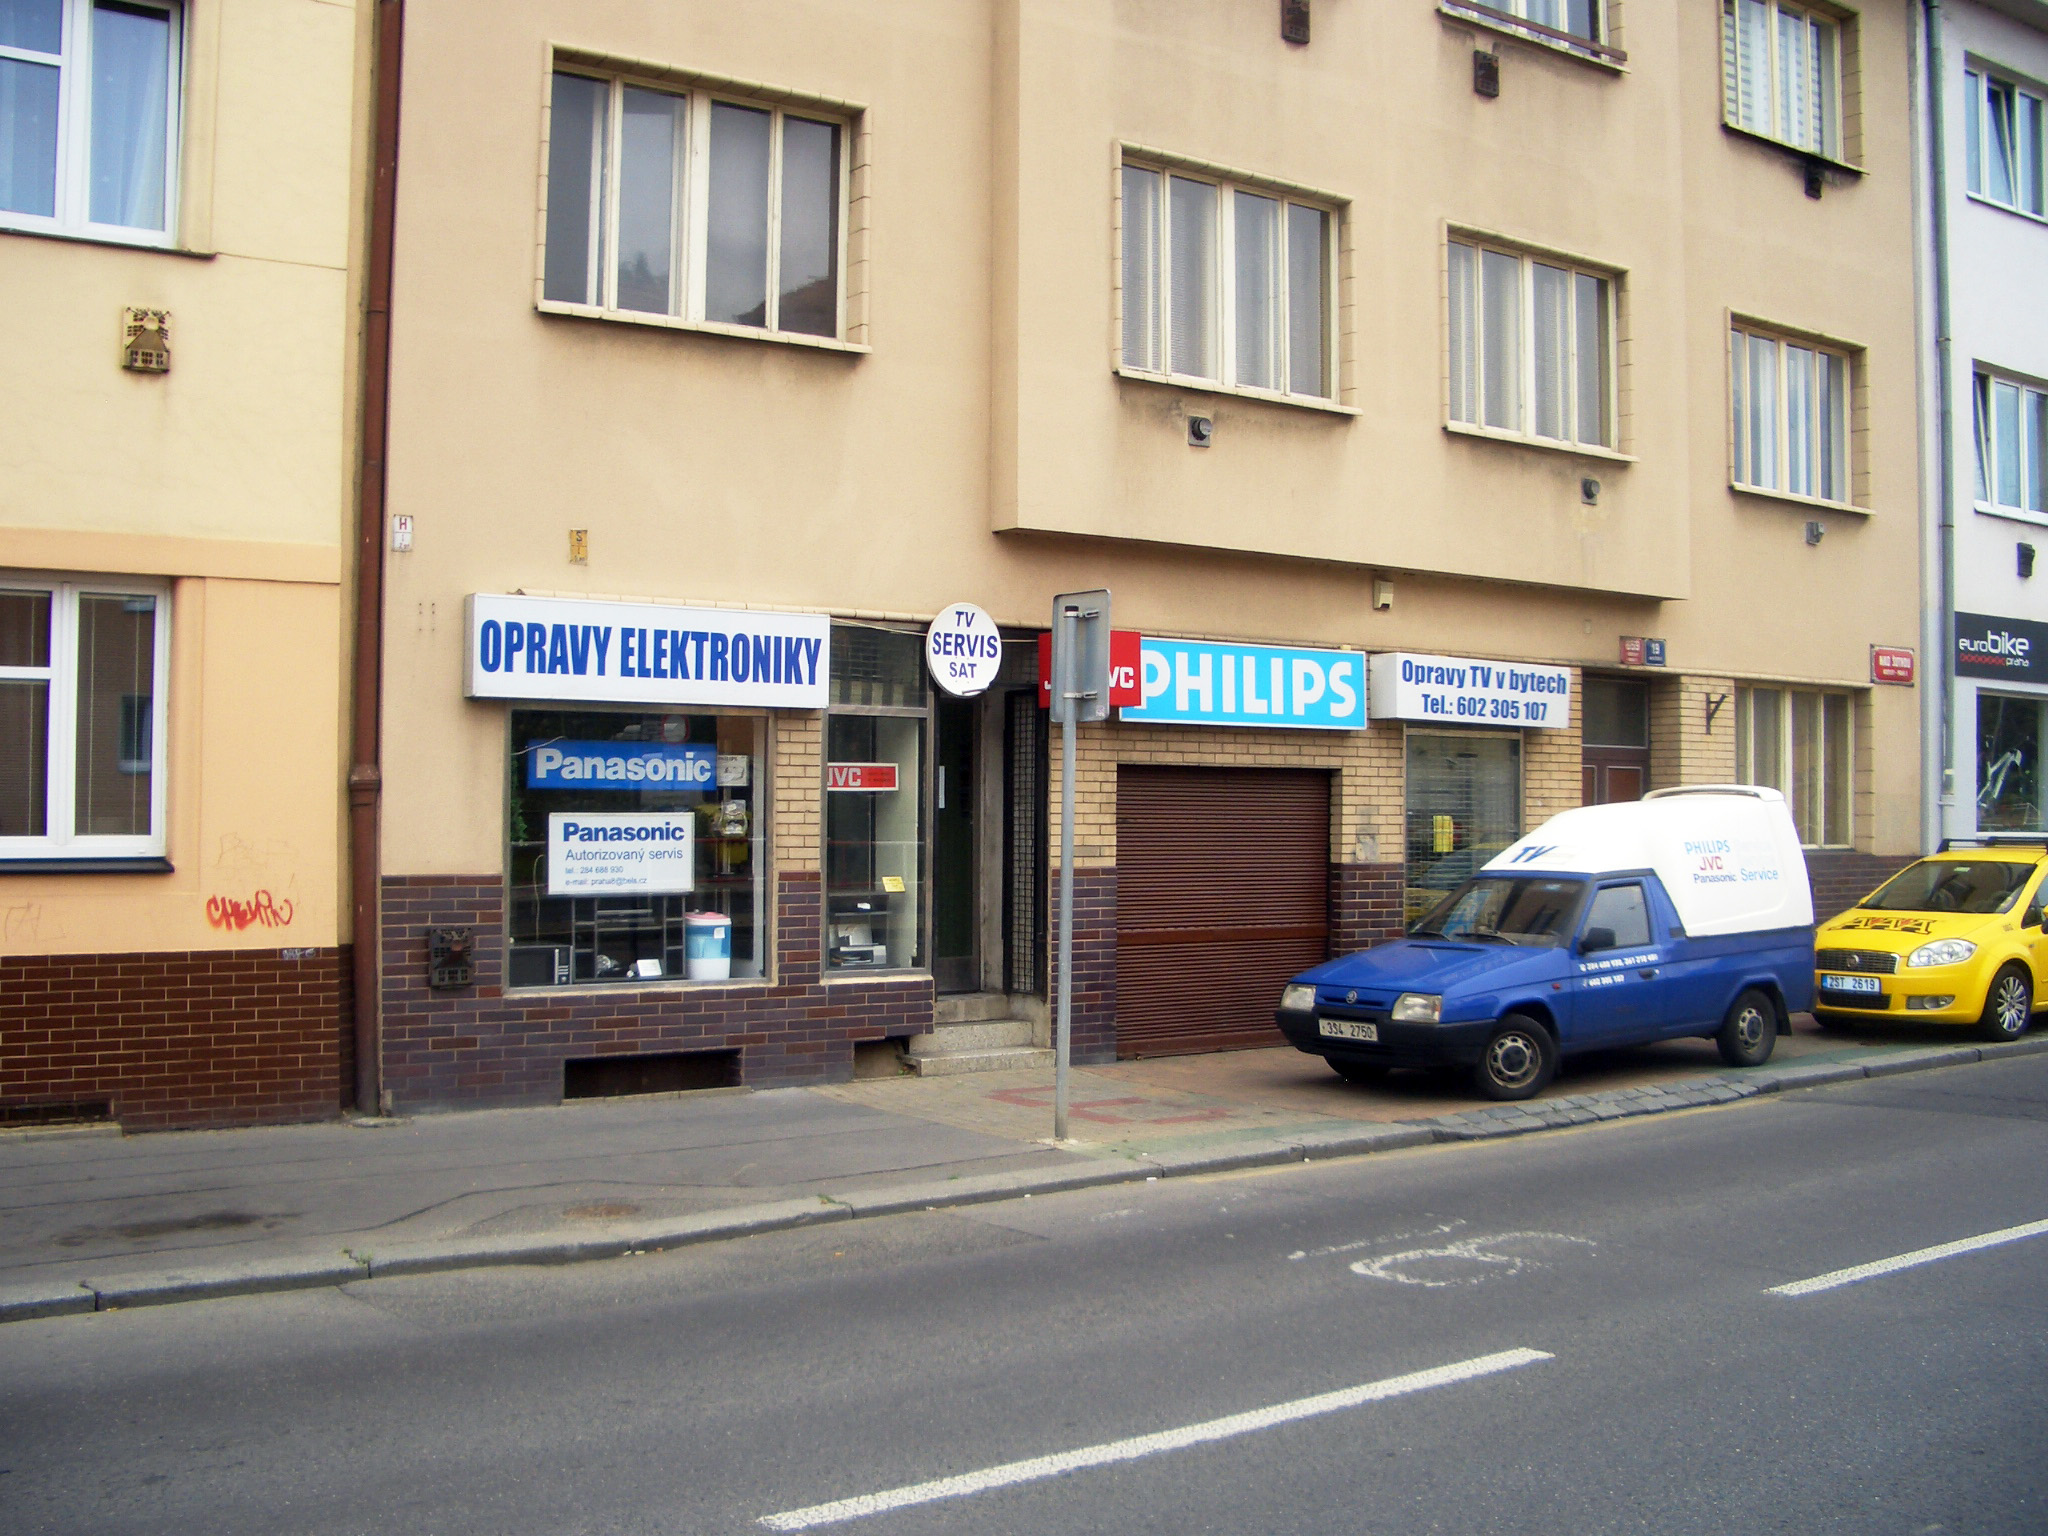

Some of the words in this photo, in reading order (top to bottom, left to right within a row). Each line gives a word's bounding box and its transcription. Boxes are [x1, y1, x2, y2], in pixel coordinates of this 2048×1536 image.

[955, 611, 976, 628] TV
[480, 619, 612, 676] OPRAVY
[620, 627, 822, 686] ELEKTRONIKY
[932, 631, 998, 659] SERVIS
[1959, 630, 2029, 656] eurobike
[949, 661, 977, 679] SAT
[1402, 659, 1466, 689] Opravy
[1469, 666, 1492, 688] TV
[1496, 671, 1506, 689] v
[1509, 669, 1567, 695] bytech
[1134, 649, 1357, 718] PHILIPS
[1421, 694, 1453, 715] Tel.:
[1456, 696, 1486, 717] 602
[1490, 699, 1520, 720] 305
[1524, 701, 1548, 721] 107
[536, 748, 712, 782] Panasonic
[827, 767, 861, 787] JVC
[563, 821, 685, 842] Panasonic
[565, 847, 645, 863] Autorizovaný
[648, 847, 684, 860] servis
[1510, 845, 1559, 863] TV
[1684, 839, 1731, 855] PHILIPS
[1699, 855, 1723, 871] JVC
[1693, 872, 1737, 884] Panasonic
[1740, 867, 1779, 882] Service
[1829, 976, 1846, 989] 2ST
[1852, 977, 1876, 990] 2619
[1350, 1023, 1373, 1039] 2750
